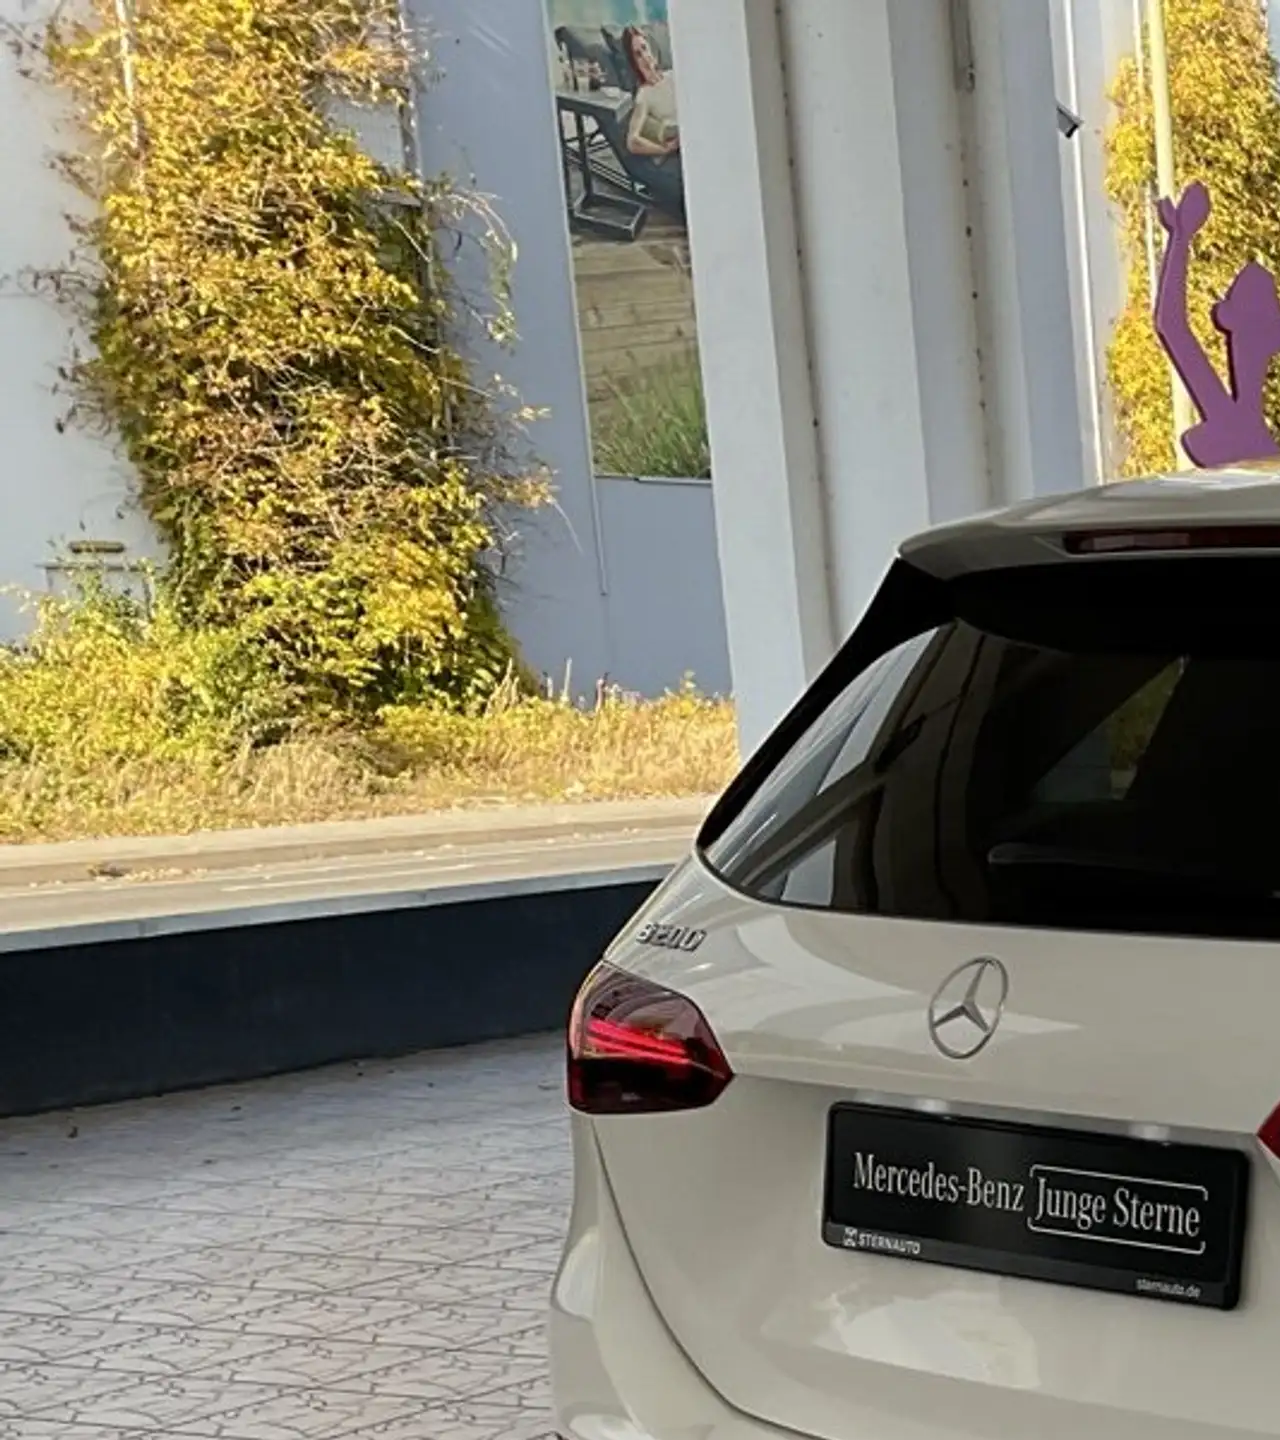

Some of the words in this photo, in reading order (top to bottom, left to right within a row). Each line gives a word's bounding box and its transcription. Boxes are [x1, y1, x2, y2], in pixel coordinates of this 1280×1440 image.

[853, 1151, 1025, 1212] Mercedes-Benz
[1034, 1176, 1107, 1230] Junge
[1112, 1186, 1201, 1238] Sterne
[858, 1231, 921, 1255] STERNAUTO
[1135, 1277, 1202, 1300] sternauto.de
